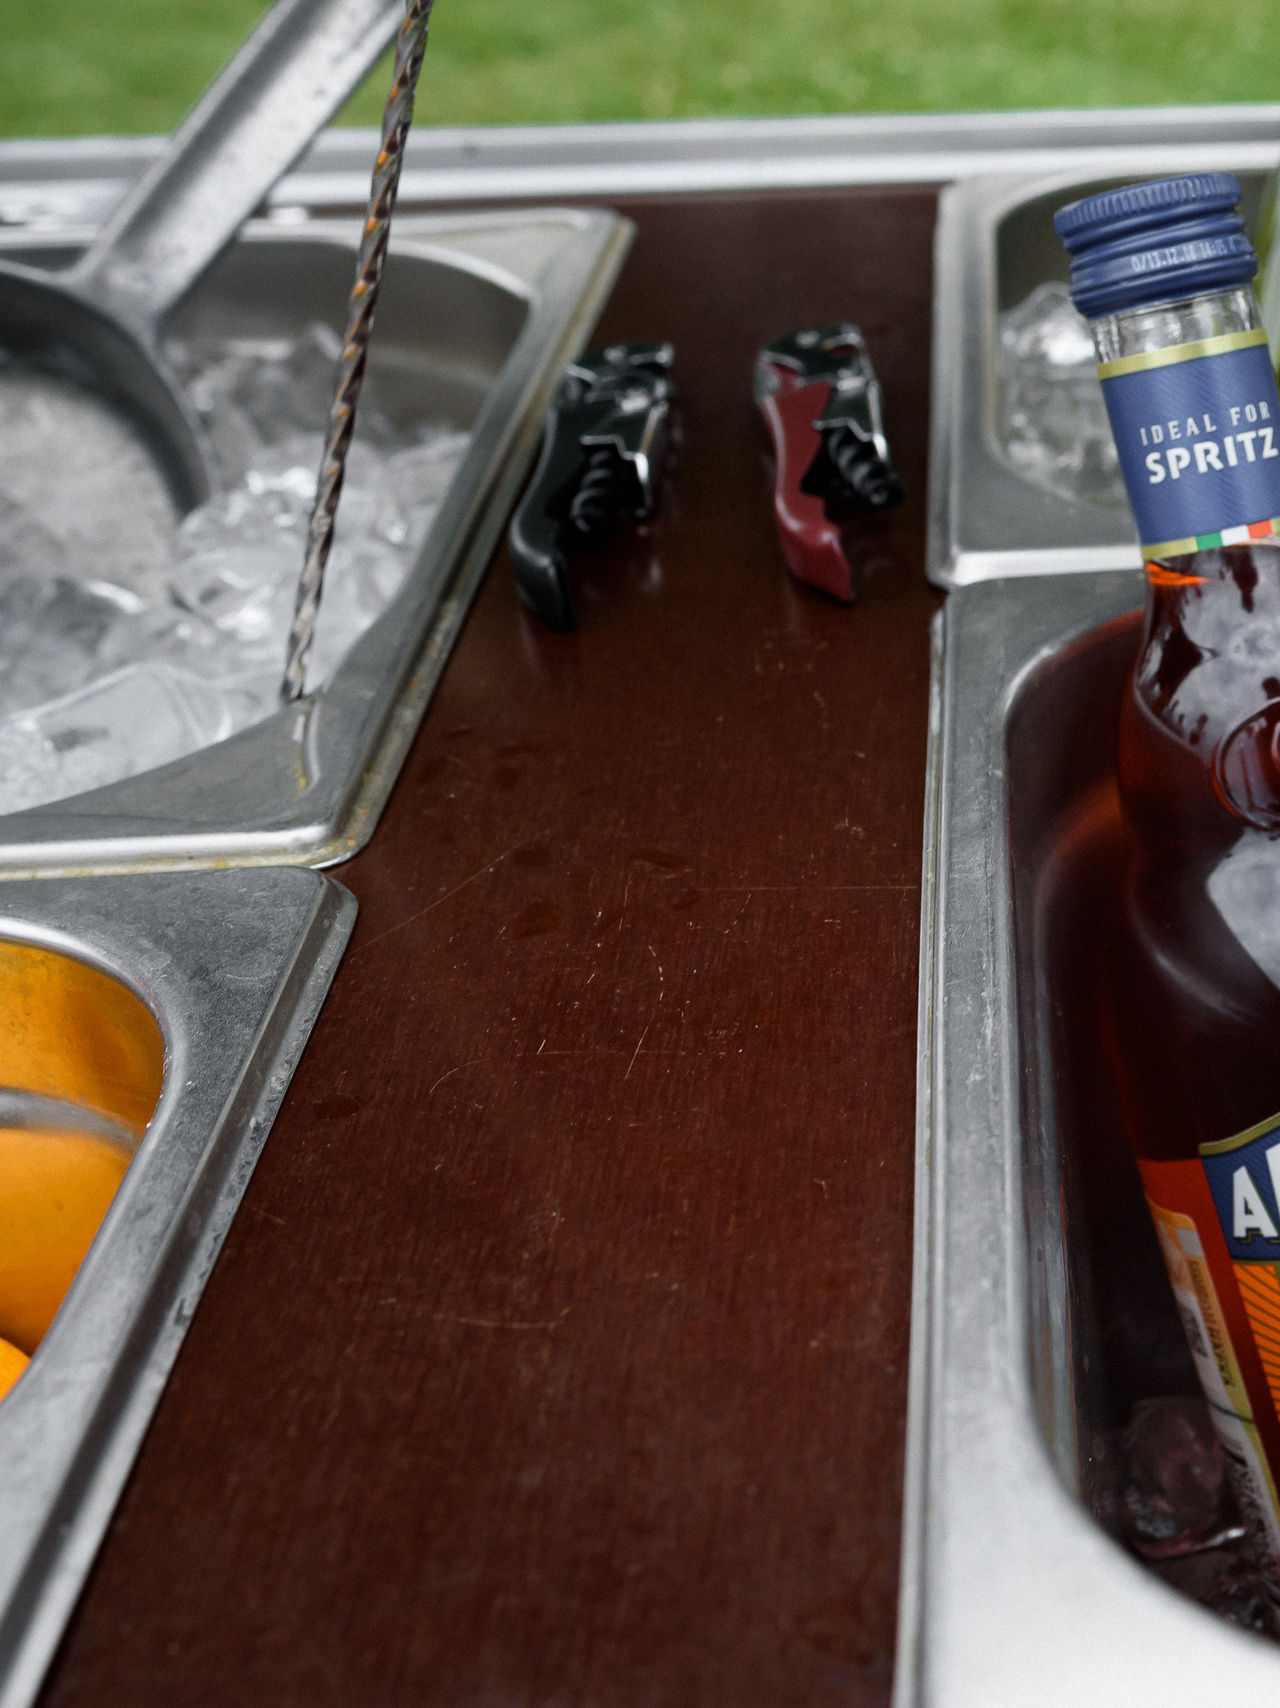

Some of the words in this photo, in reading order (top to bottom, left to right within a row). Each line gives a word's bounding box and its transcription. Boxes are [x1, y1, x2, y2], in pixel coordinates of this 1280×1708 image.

[1139, 413, 1217, 447] IDEAL
[1229, 400, 1270, 426] FOR
[1145, 426, 1279, 484] SPRITZ
